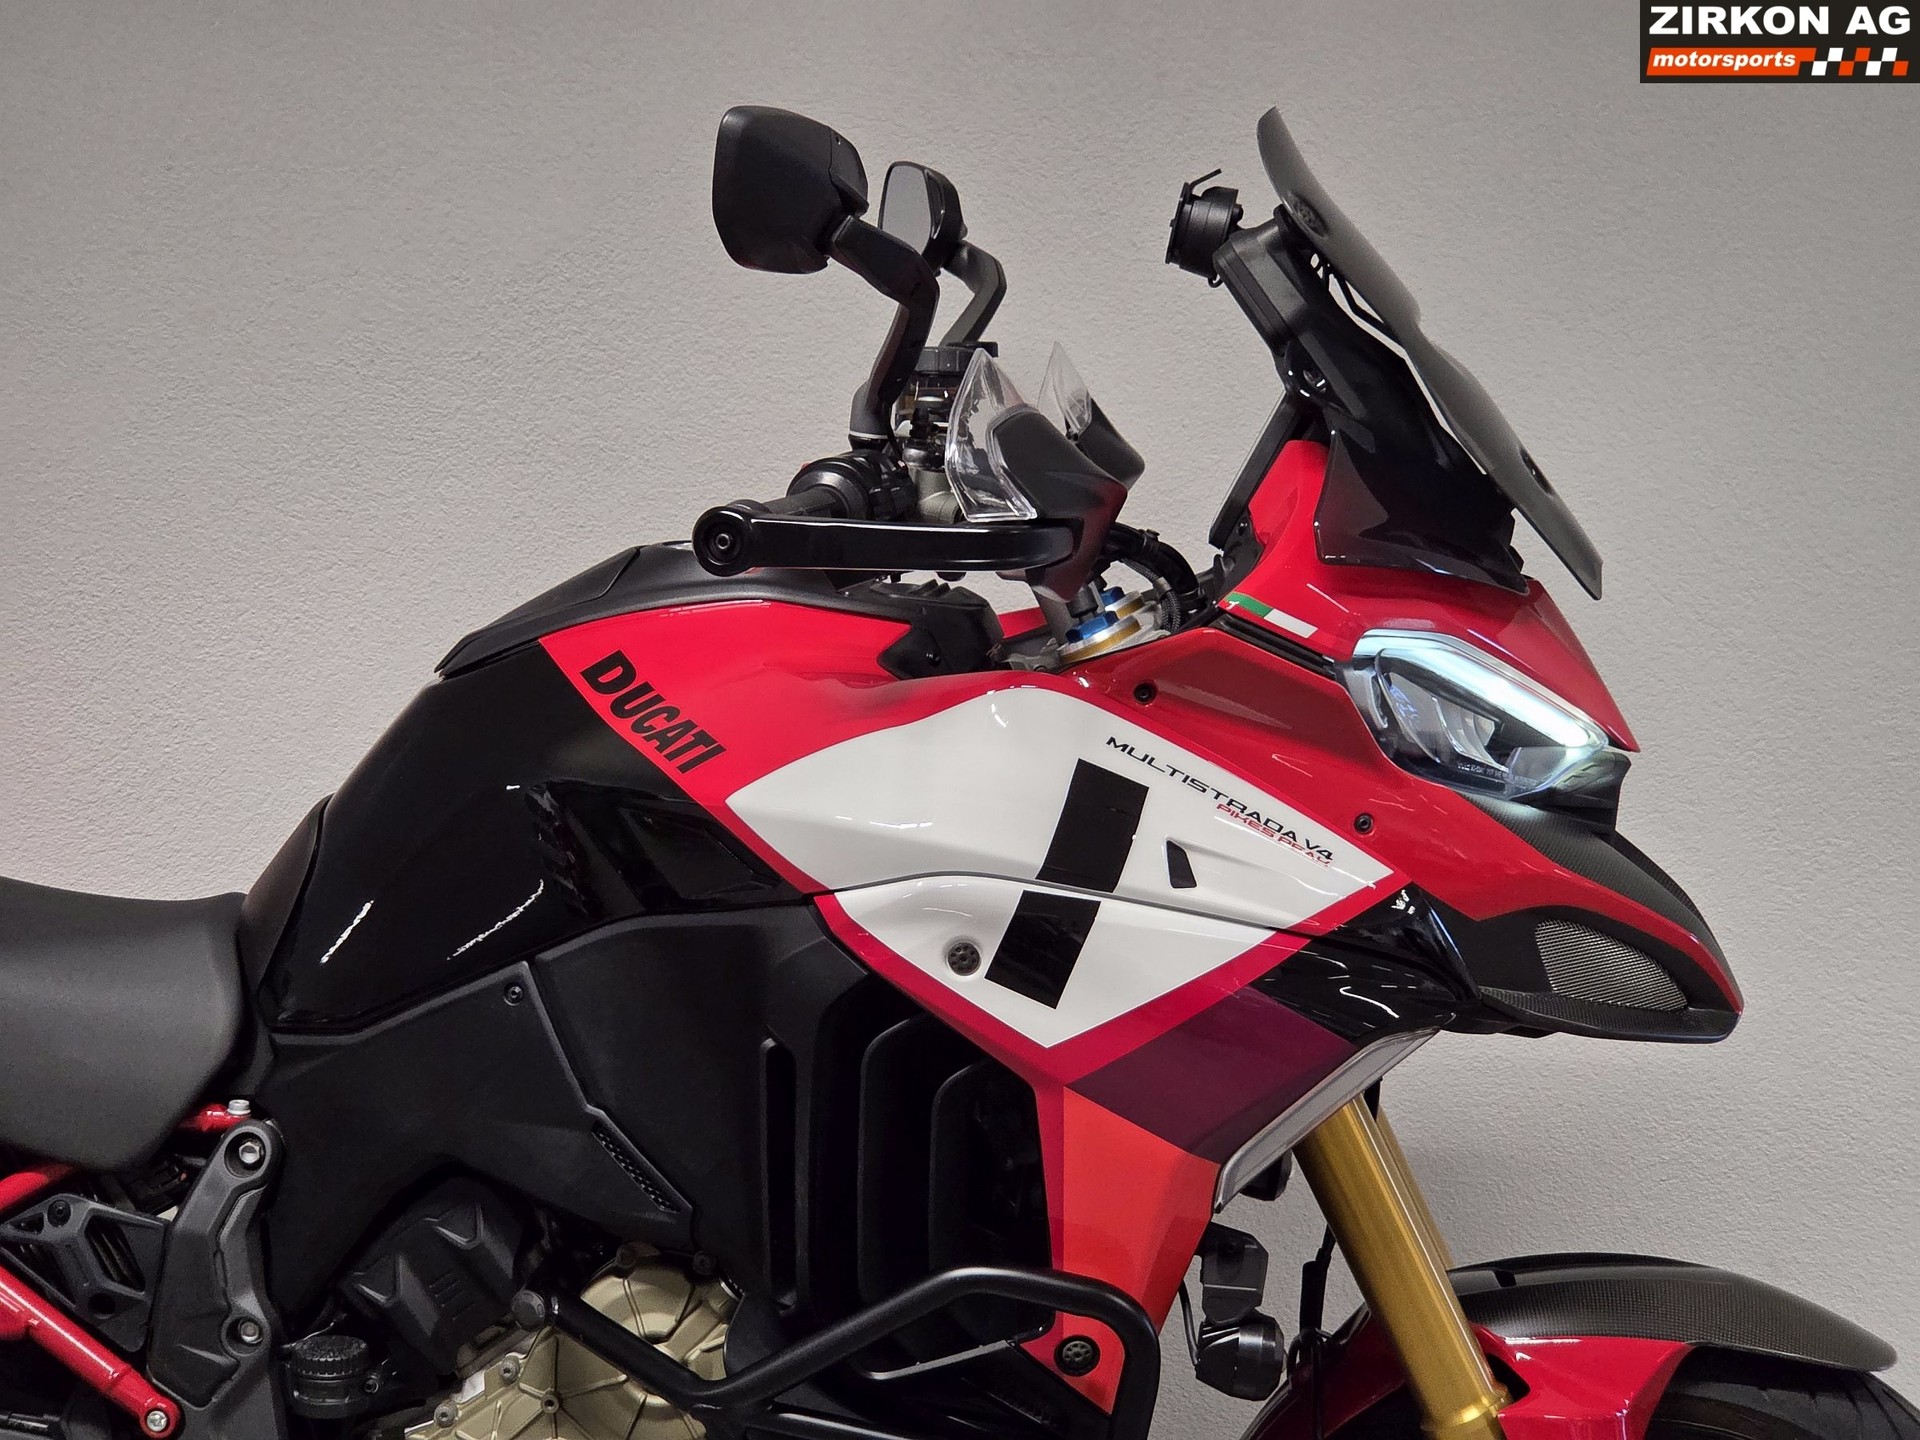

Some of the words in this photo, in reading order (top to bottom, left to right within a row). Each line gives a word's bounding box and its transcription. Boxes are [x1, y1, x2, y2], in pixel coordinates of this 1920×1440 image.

[580, 649, 727, 774] DUCATI
[1106, 736, 1298, 842] MULTISTRADA
[1305, 838, 1334, 861] V4
[1216, 803, 1276, 838] PIKES
